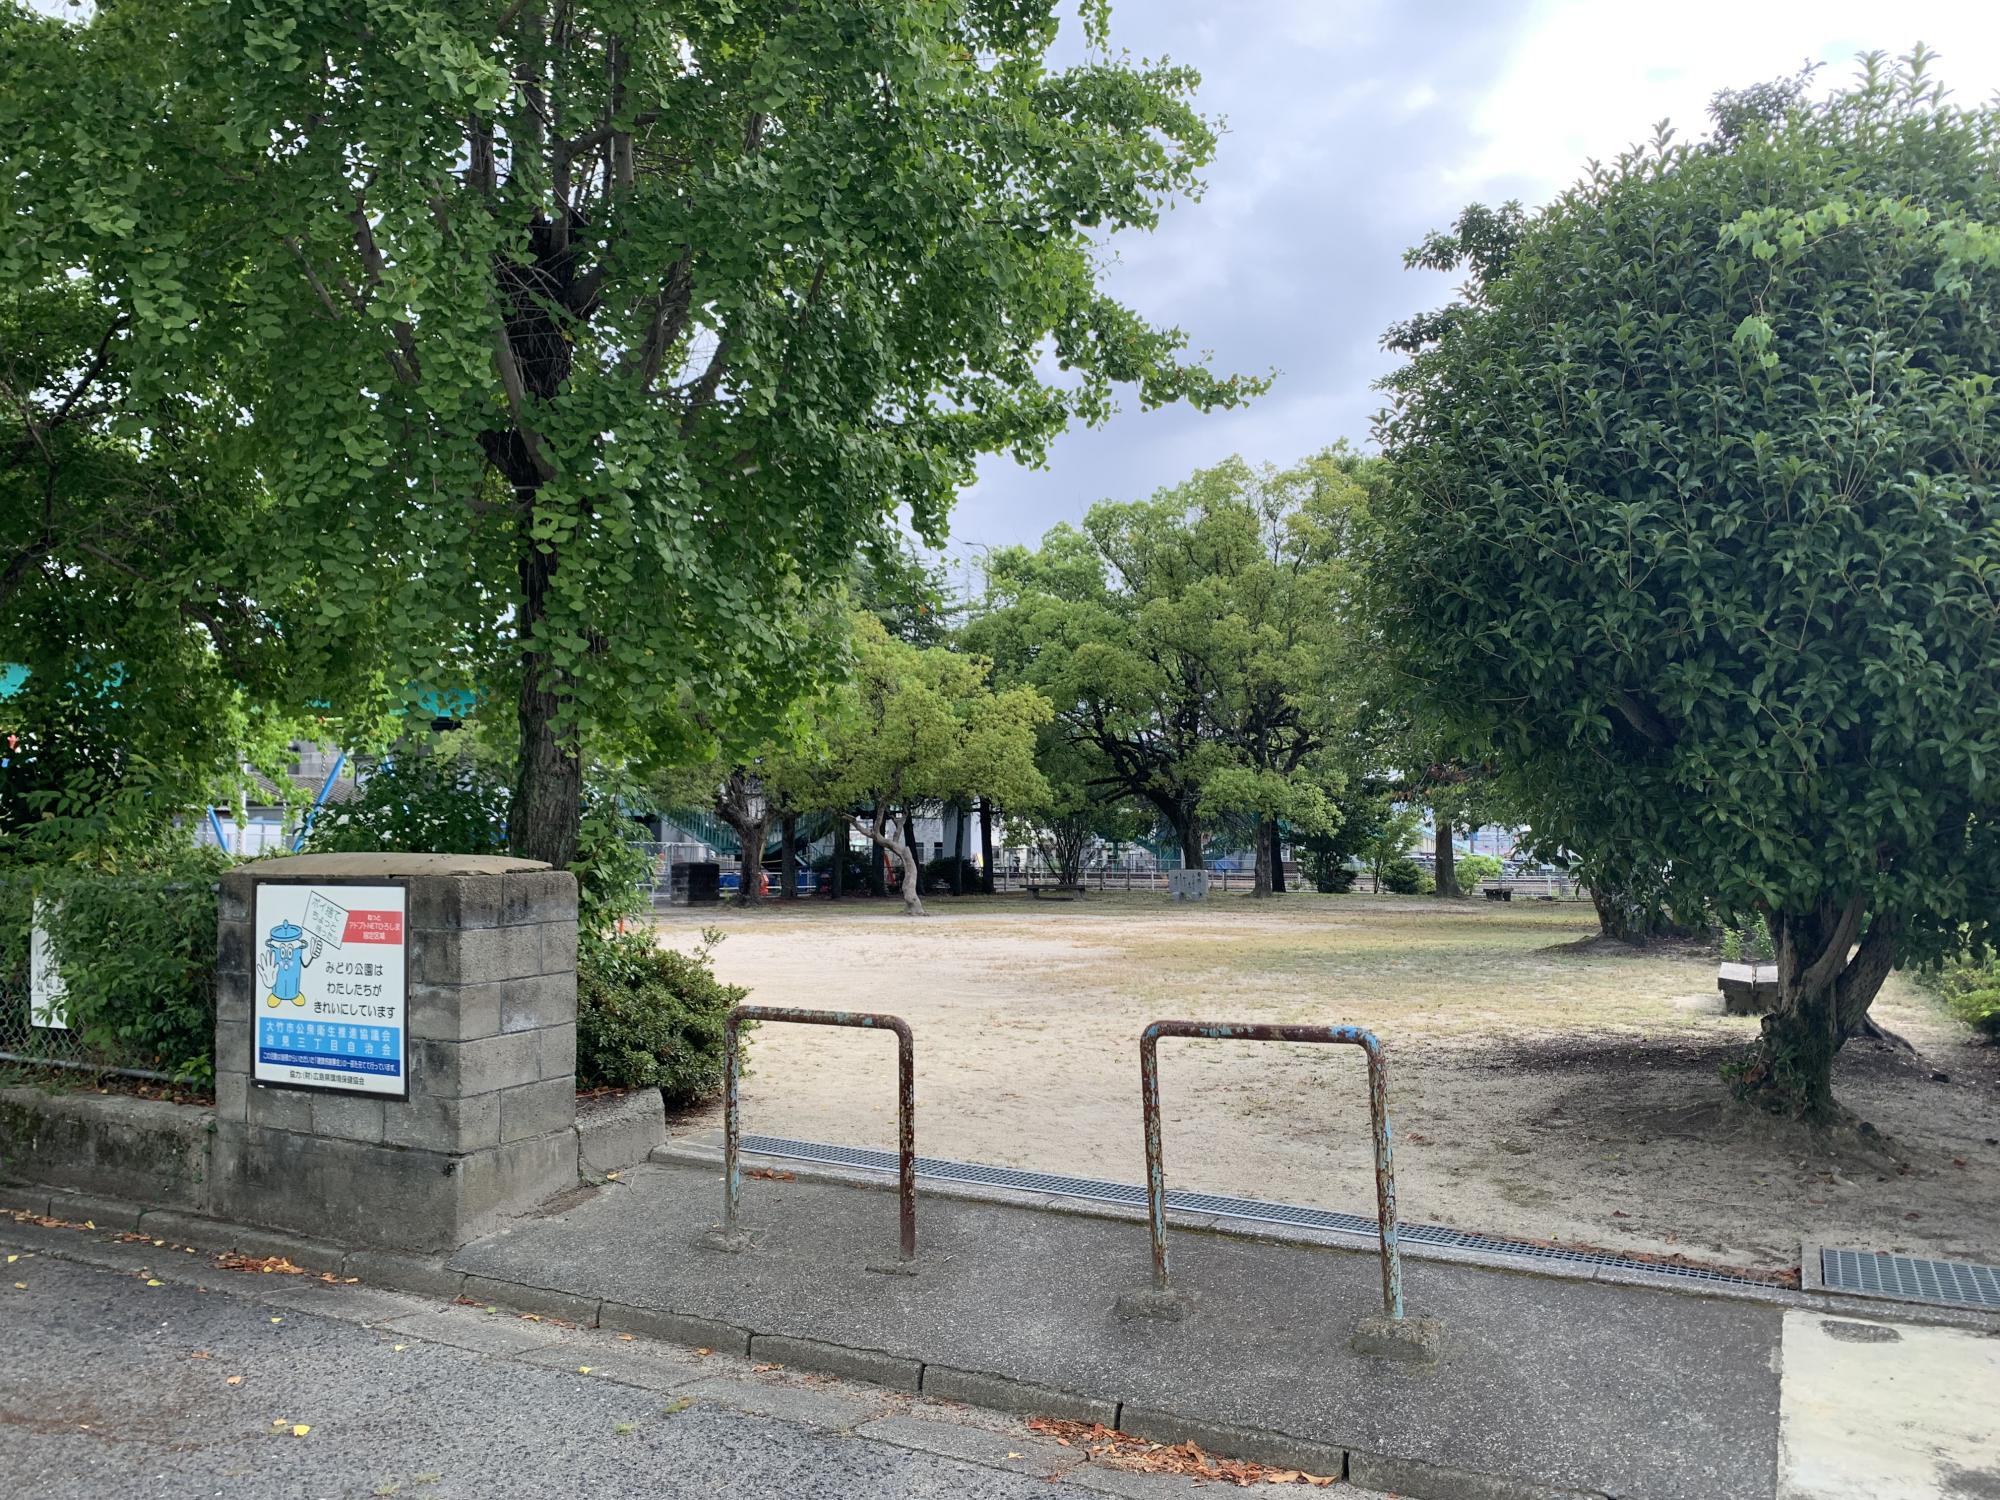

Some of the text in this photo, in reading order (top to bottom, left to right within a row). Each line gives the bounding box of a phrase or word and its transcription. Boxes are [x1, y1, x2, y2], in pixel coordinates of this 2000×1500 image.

[325, 961, 384, 977] みどり公園は
[326, 982, 383, 997] わたしたちが
[313, 1001, 396, 1019] きれいにしています
[266, 1021, 392, 1042] 大竹市公衆衛生推進協議会
